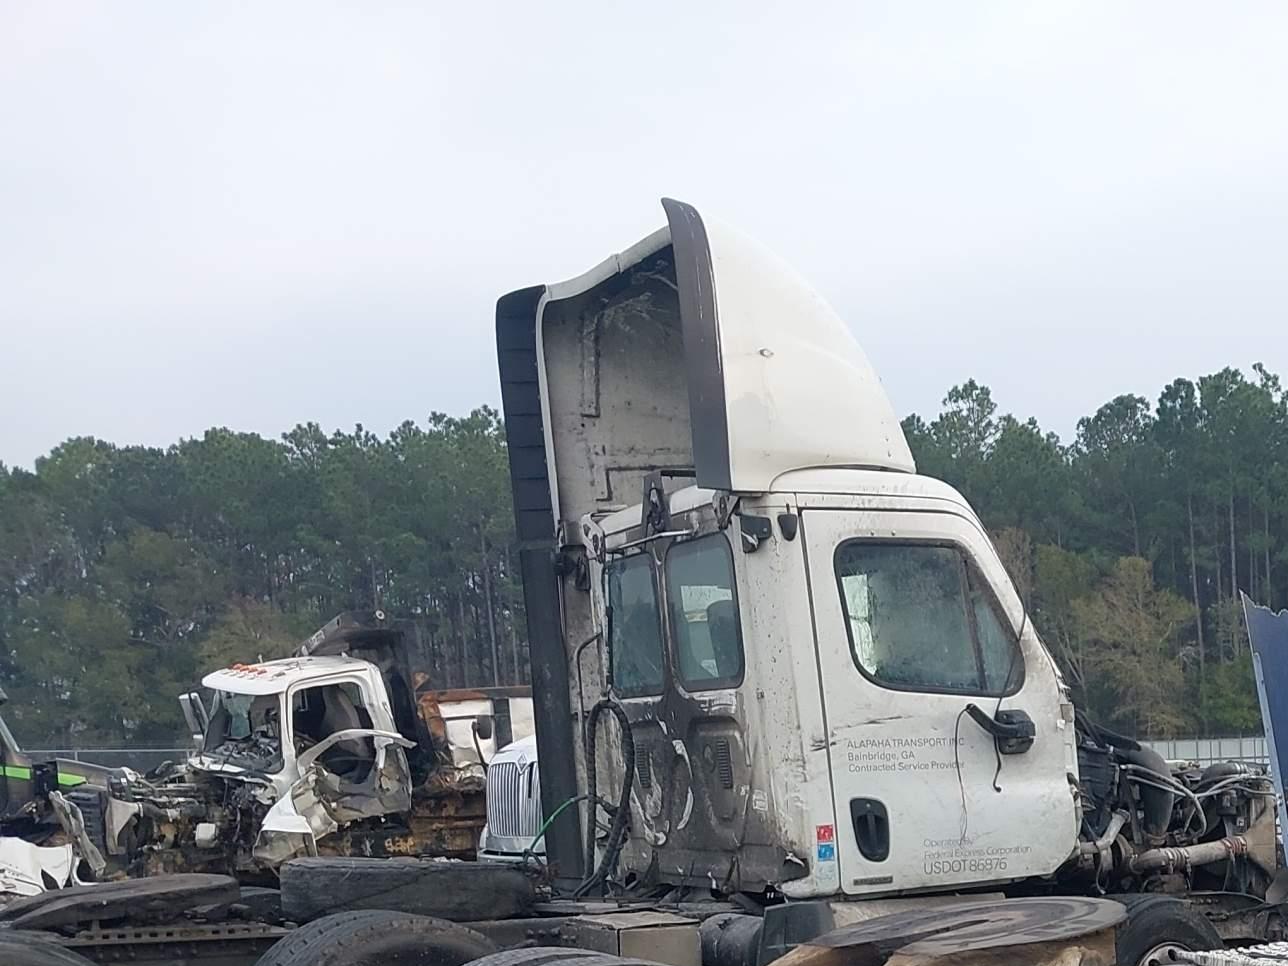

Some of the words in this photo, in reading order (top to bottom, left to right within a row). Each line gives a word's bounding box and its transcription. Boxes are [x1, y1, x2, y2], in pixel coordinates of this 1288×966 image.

[847, 738, 890, 749] ALAPAHA
[891, 737, 946, 748] TRANSPORT
[948, 737, 965, 747] INC
[847, 751, 900, 762] Bainbridge,
[900, 750, 916, 760] GA
[848, 763, 896, 773] Contracted
[897, 761, 930, 771] Service
[923, 838, 961, 848] Operated
[924, 848, 954, 860] Federal
[955, 847, 986, 858] Express
[986, 845, 1033, 857] Corporation
[923, 859, 968, 876] USDOT
[969, 857, 1008, 873] 86876
